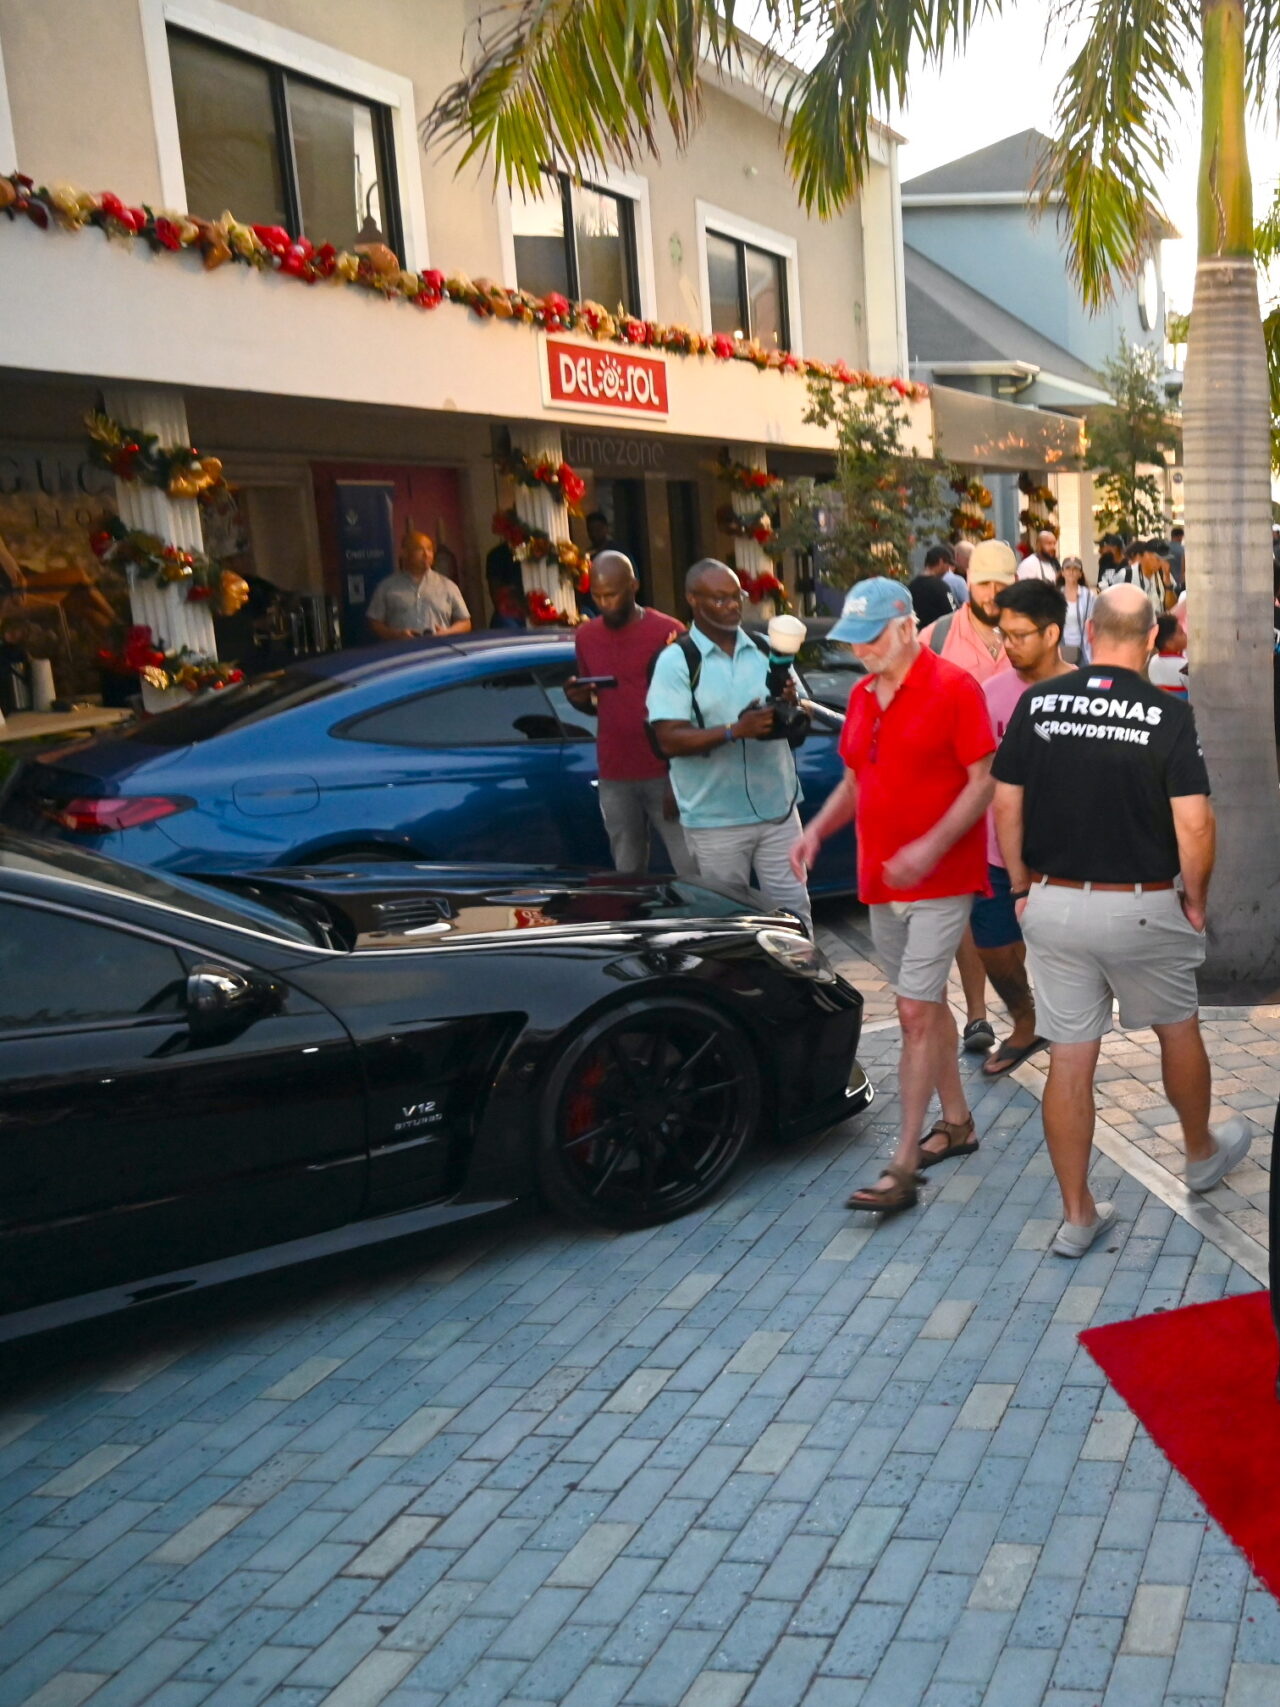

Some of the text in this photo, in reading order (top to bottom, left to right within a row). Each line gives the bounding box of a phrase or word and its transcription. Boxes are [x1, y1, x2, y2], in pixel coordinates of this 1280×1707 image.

[559, 352, 659, 406] DEL SOL
[566, 430, 665, 468] timezone
[1029, 694, 1163, 726] PETRONAS
[1040, 720, 1150, 746] CROWDSTRIKE
[402, 1101, 436, 1117] V12
